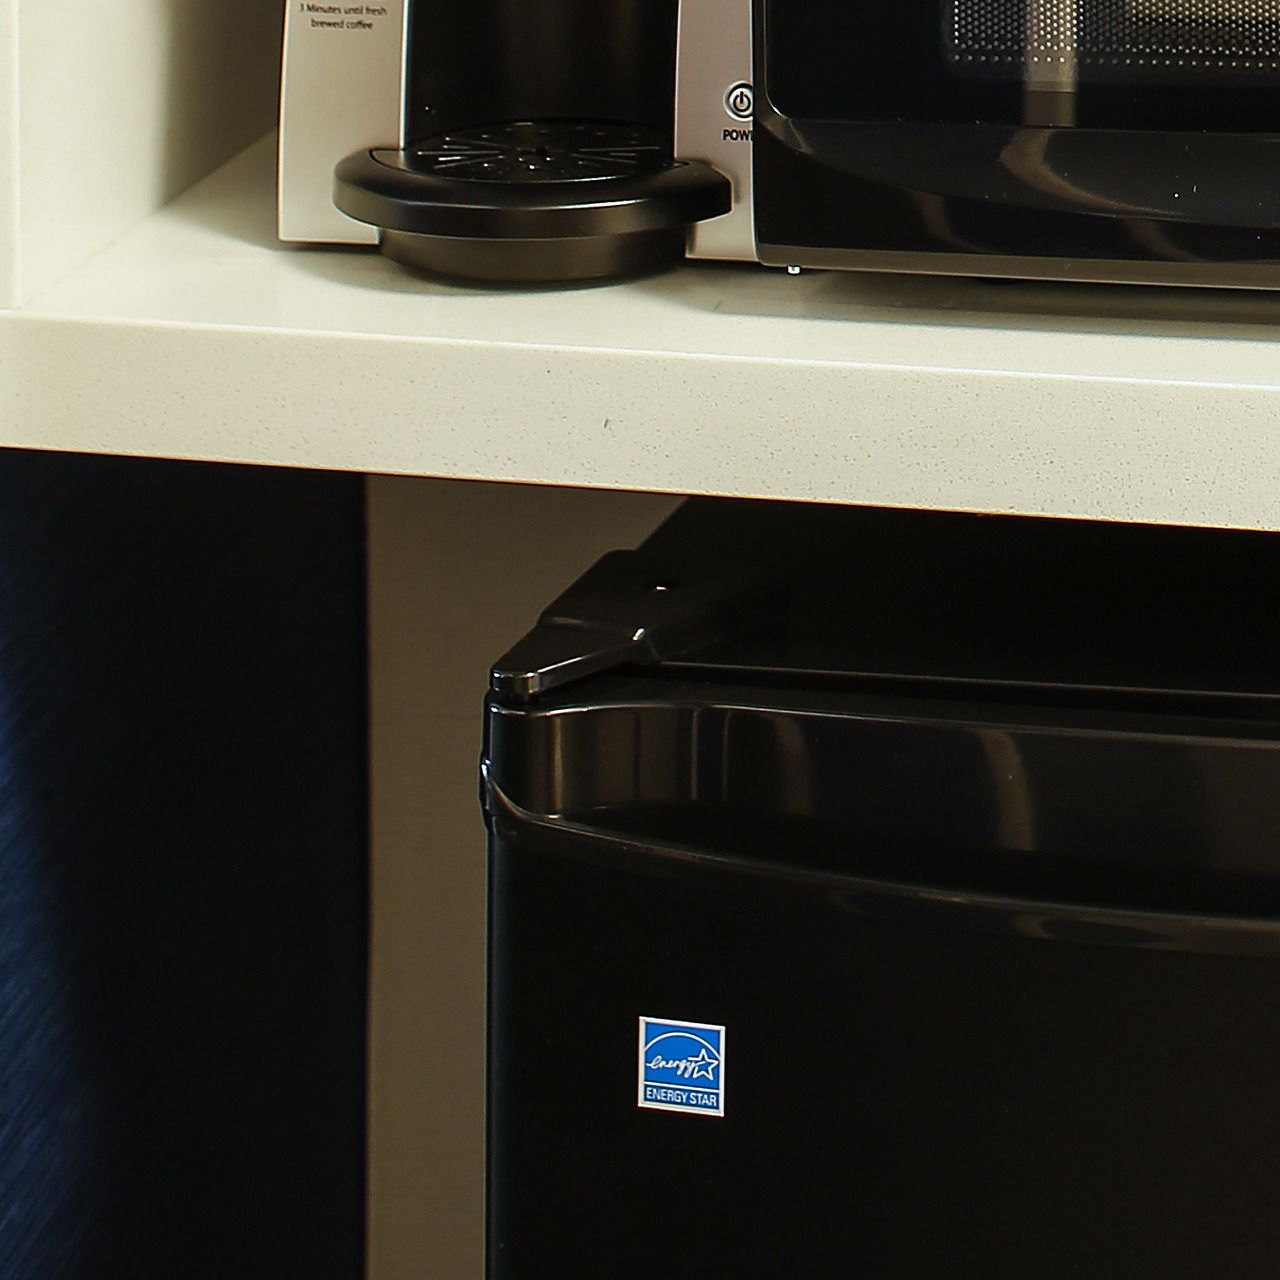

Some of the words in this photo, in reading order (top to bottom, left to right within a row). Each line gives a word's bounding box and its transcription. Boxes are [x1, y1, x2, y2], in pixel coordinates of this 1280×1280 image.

[343, 5, 364, 15] until
[365, 5, 388, 16] fresh
[310, 18, 345, 29] brewed
[345, 19, 374, 30] coffee
[722, 128, 753, 141] POW
[645, 1086, 689, 1103] ENERGY
[689, 1091, 718, 1107] STAR
